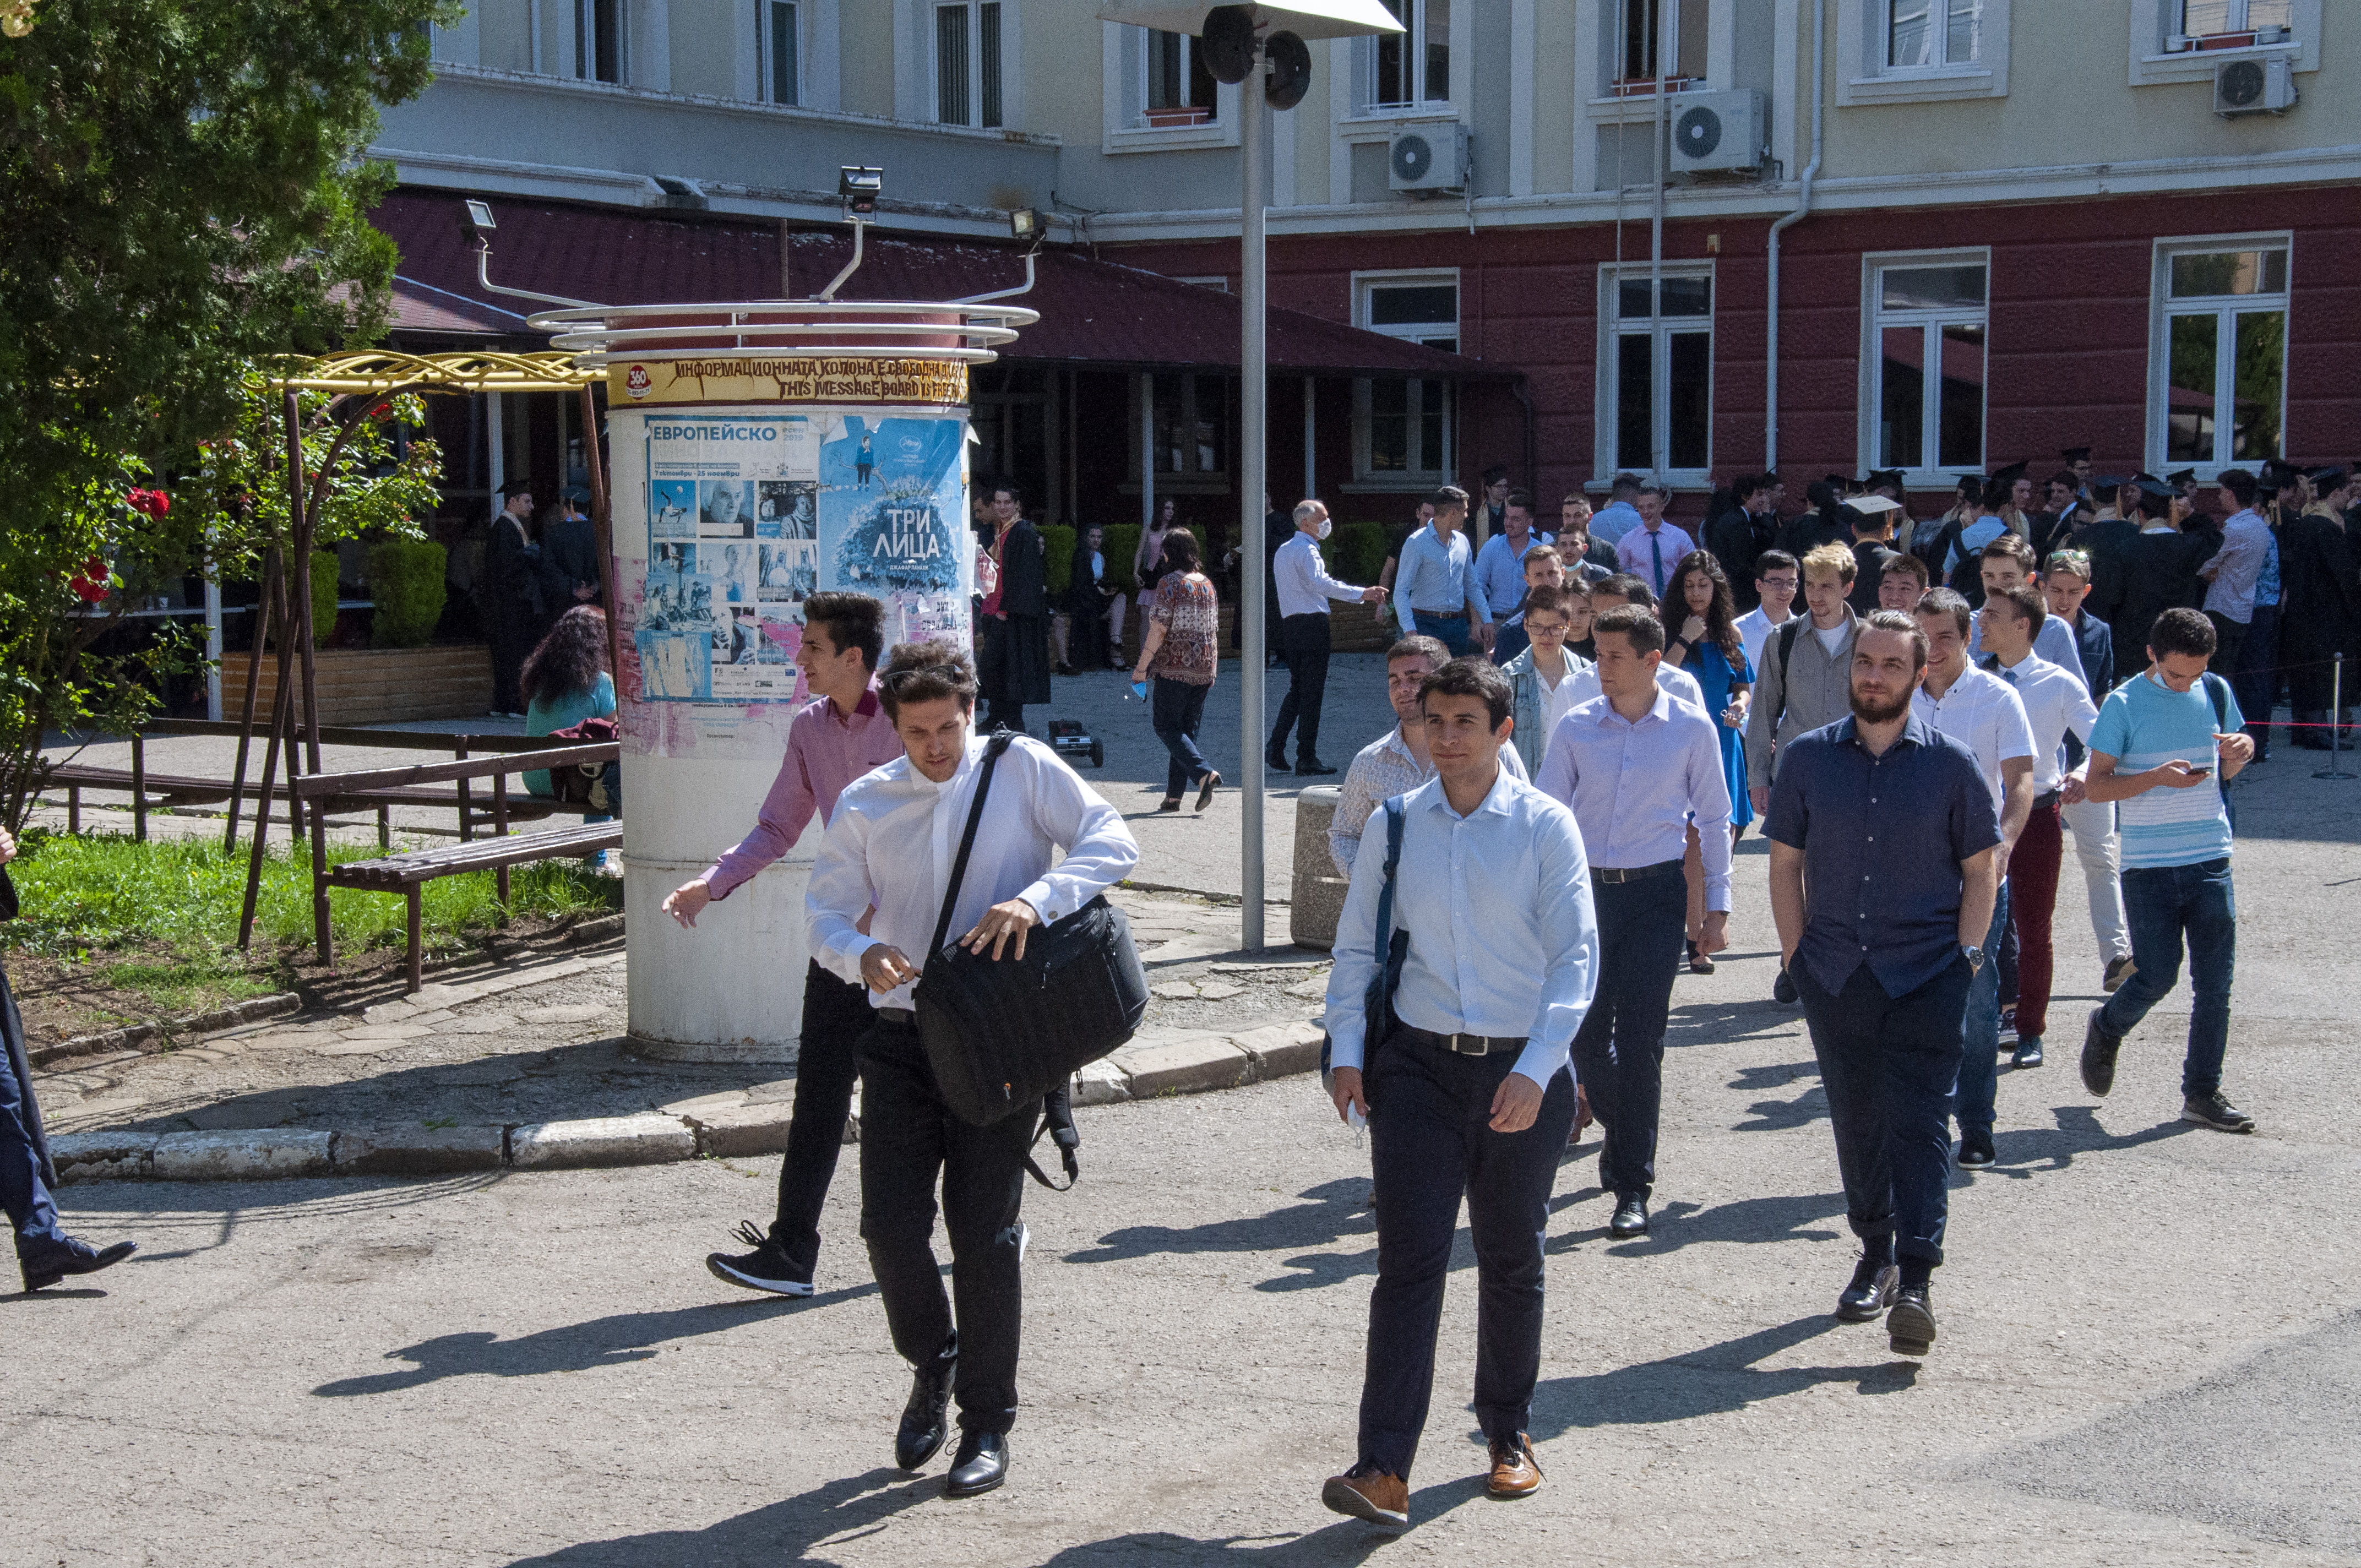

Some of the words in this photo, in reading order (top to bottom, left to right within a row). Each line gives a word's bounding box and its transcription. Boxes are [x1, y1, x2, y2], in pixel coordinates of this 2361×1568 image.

[630, 370, 646, 385] 360
[676, 361, 815, 377] ИНФОРМАЦИОННАТА
[821, 361, 877, 377] КОЛОНА
[888, 362, 940, 377] СВОБОДНА
[780, 380, 811, 396] THIS
[815, 380, 880, 396] MESSAGE
[882, 381, 919, 396] BOARD
[922, 382, 931, 396] IS
[654, 423, 777, 441] ЕВРОПЕЙСКО
[887, 509, 930, 533] ТРИ
[873, 533, 940, 561] ЛИЦА
